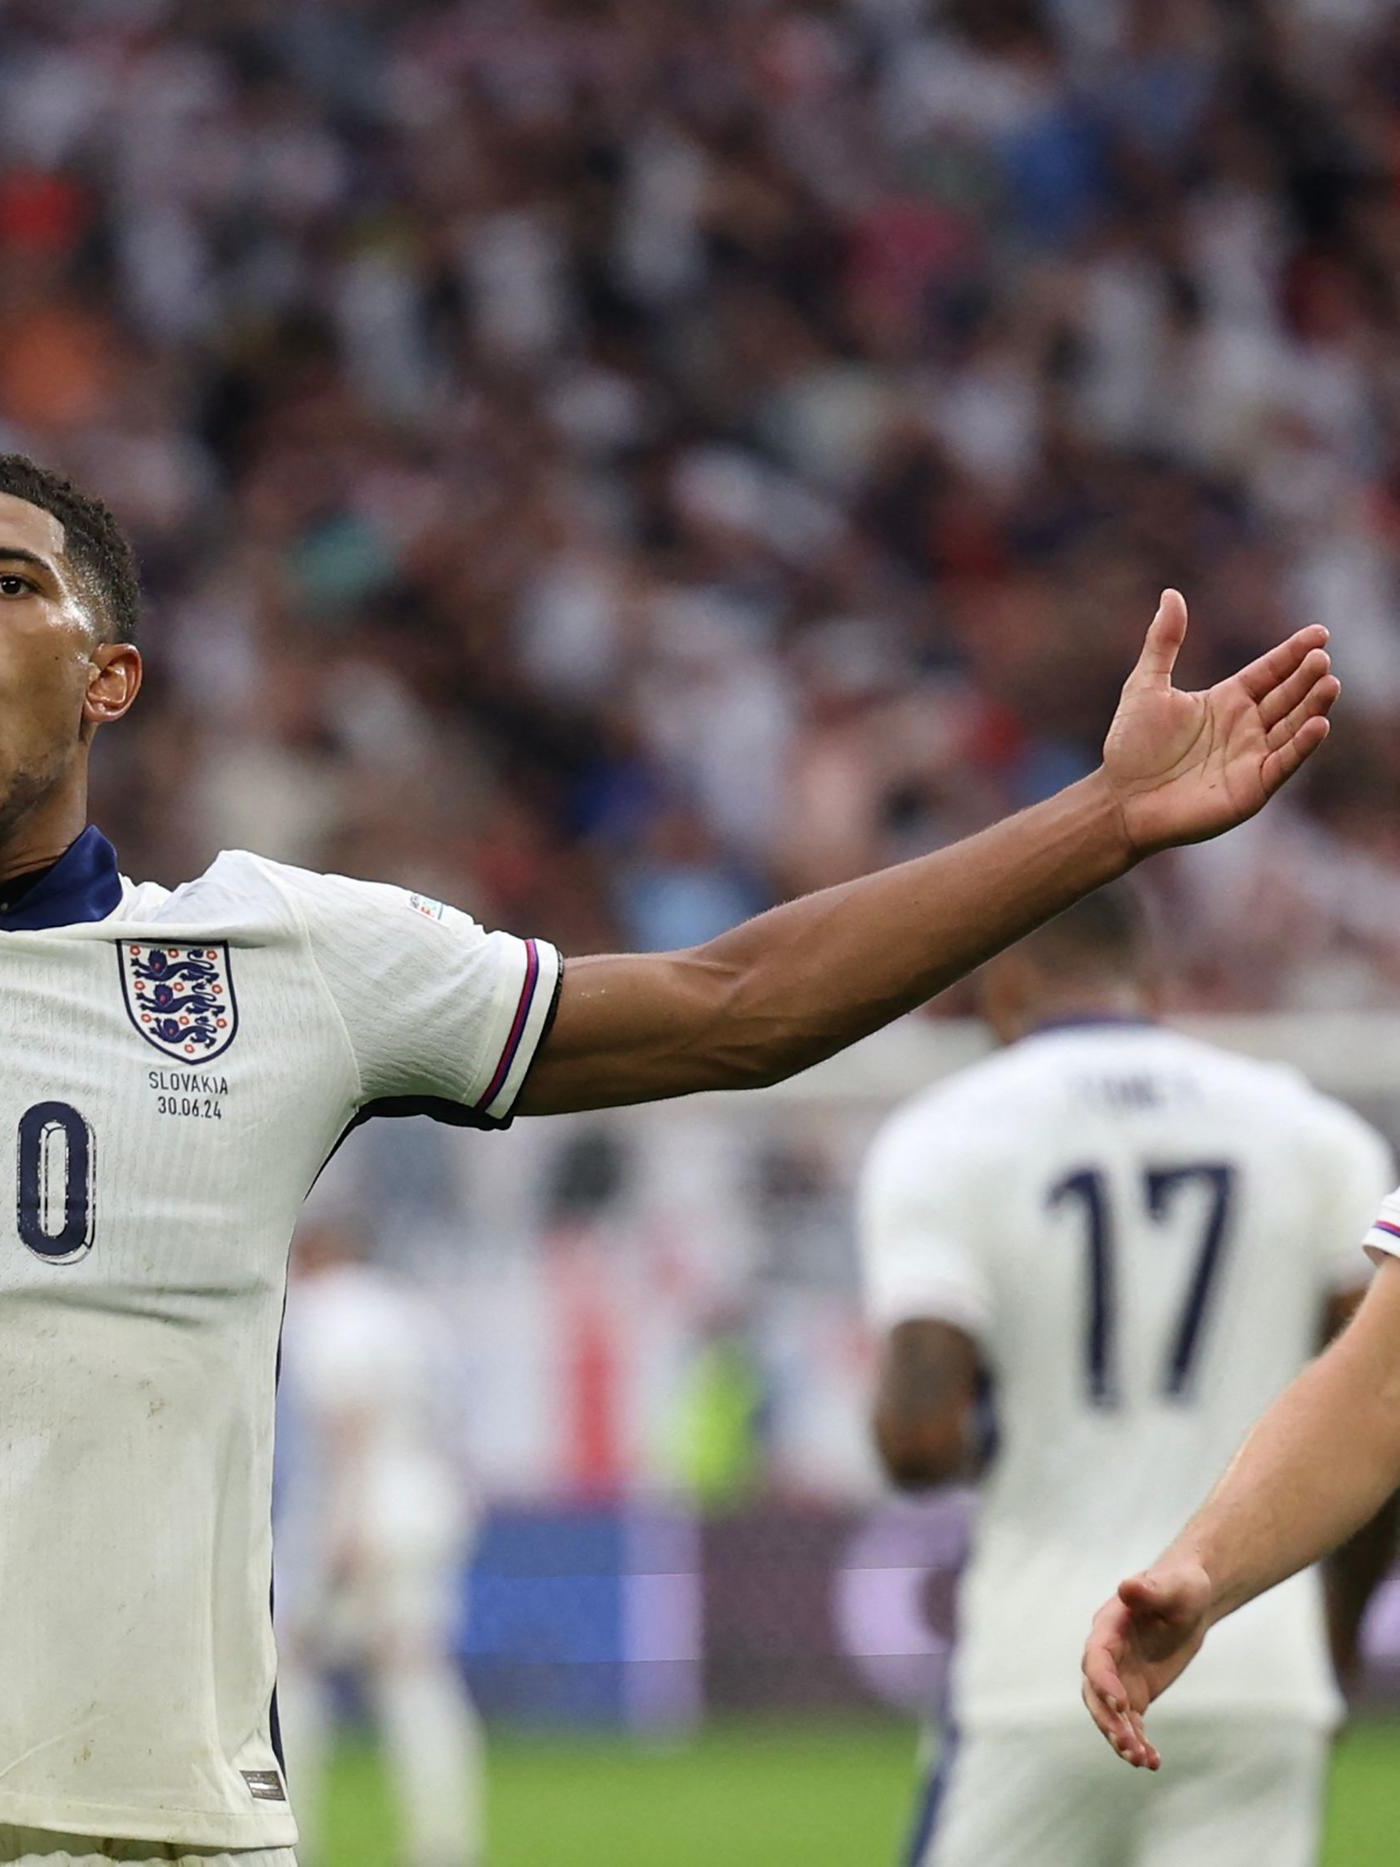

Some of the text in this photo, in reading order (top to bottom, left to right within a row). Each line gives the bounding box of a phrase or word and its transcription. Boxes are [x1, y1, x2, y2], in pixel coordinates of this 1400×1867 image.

[148, 1071, 228, 1095] SLOVAKIA
[157, 1096, 221, 1120] 30.06.24
[1045, 1162, 1238, 1406] 17
